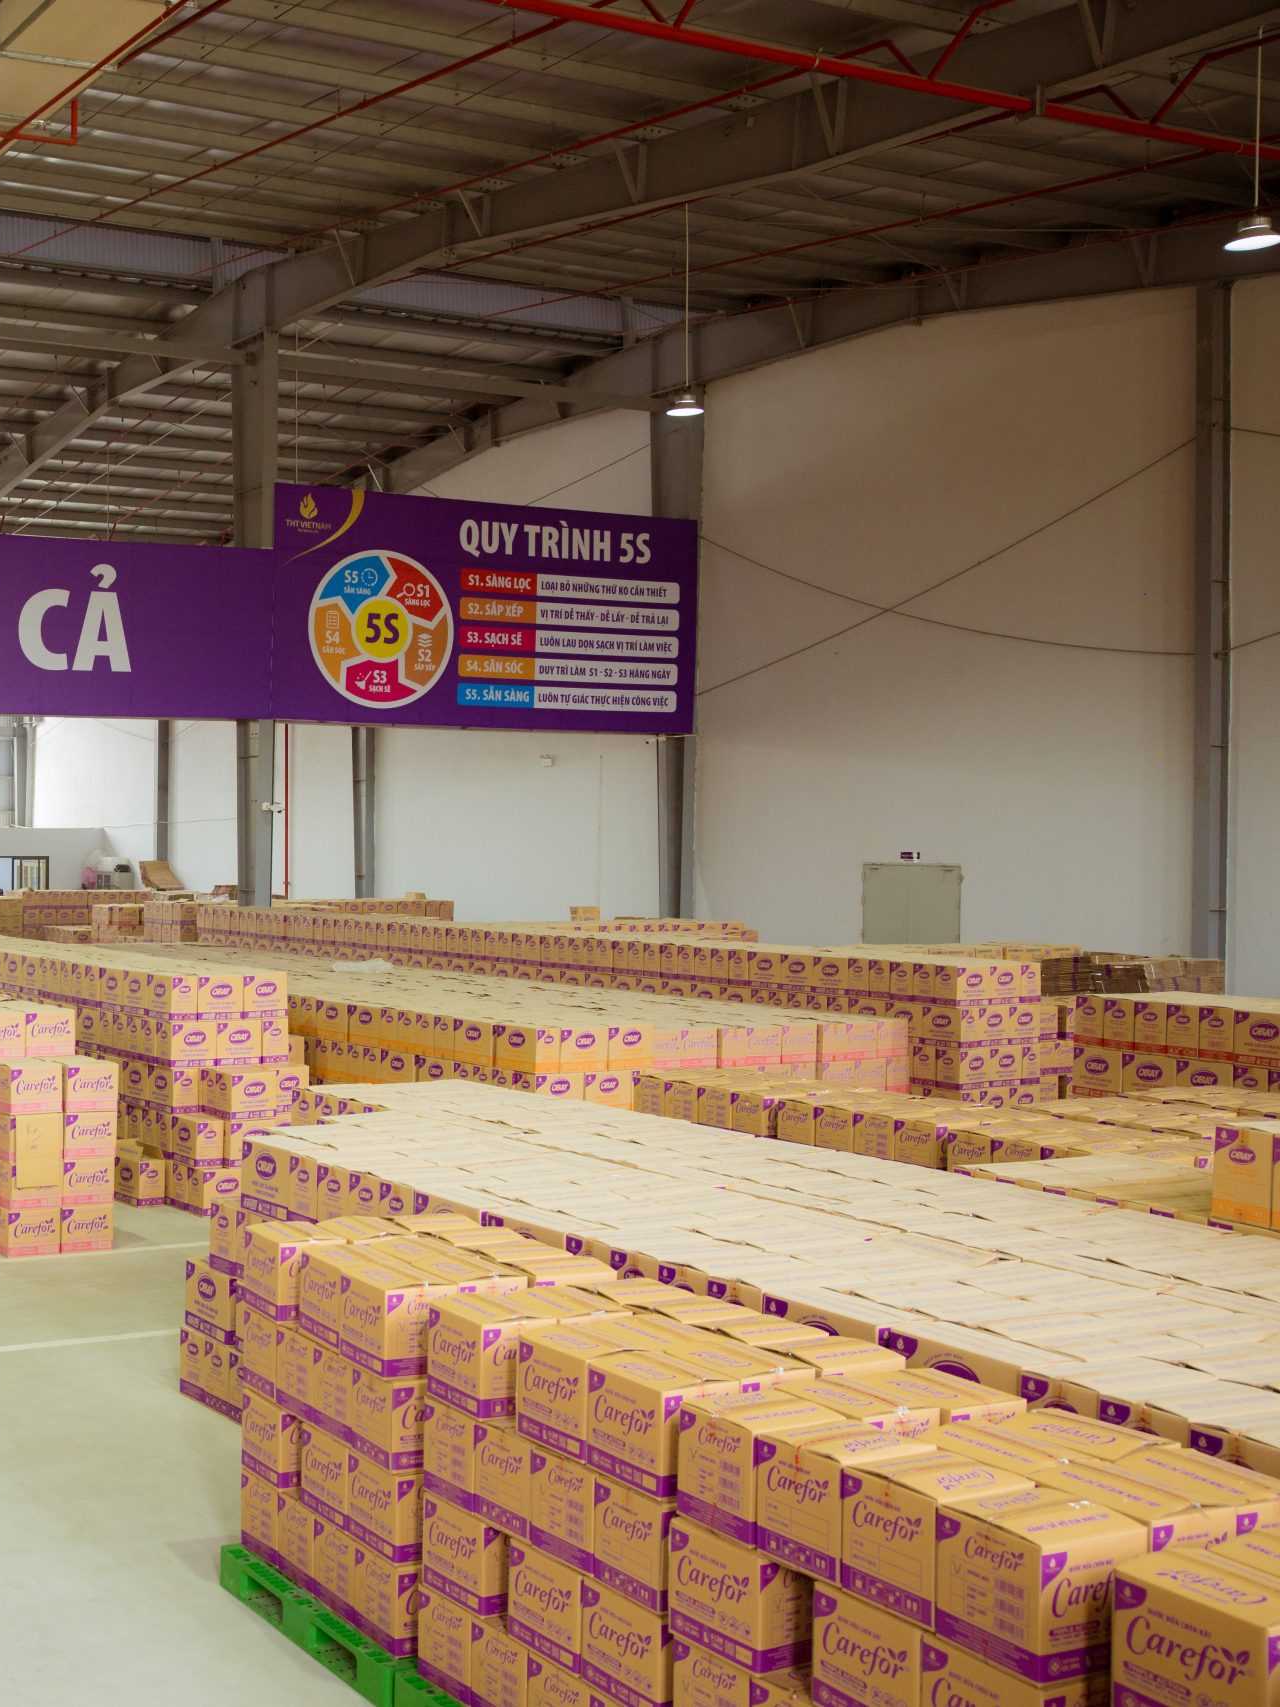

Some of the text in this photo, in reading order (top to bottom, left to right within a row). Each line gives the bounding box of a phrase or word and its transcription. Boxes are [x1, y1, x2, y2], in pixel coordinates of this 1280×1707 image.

[286, 519, 332, 530] THT VIETNAM
[460, 519, 651, 564] QUY TRÌNH 5S
[344, 570, 358, 583] S5
[468, 574, 531, 592] S1. SÀNG LỌC
[417, 584, 430, 597] S1
[542, 581, 558, 593] LOẠI
[560, 580, 570, 592] BỎ
[572, 582, 600, 594] NHỮNG
[620, 586, 628, 596] KO
[468, 599, 523, 617] S2. SẮP XẾP
[18, 564, 131, 673] CẢ
[540, 609, 548, 620] VỊ
[550, 609, 562, 619] TRÍ
[657, 616, 668, 627] LẠI
[326, 630, 339, 644] S4
[365, 612, 400, 644] 5S
[467, 632, 482, 644] S3.
[484, 632, 508, 648] SẠCH
[540, 636, 672, 654] LUÔN LAU DỌN SẠCH VỊ TRÍ LÀM VIỆC
[418, 648, 432, 662] S2
[466, 660, 481, 672] S4.
[505, 660, 523, 674] SÓC
[539, 666, 554, 674] DUY
[556, 666, 568, 675] TRÌ
[570, 666, 586, 676] LÀM
[589, 668, 598, 676] S1
[604, 668, 612, 676] S2
[620, 669, 628, 678] S3
[652, 670, 670, 680] NGÀY
[373, 670, 386, 683] S3
[466, 688, 480, 700] S5.
[504, 688, 530, 702] SÀNG
[538, 692, 668, 708] LUÔN TỰ GIÁC THỰC HIỆN CÔNG VIỆC
[211, 986, 231, 998] OBAY
[256, 984, 276, 996] OBAY
[31, 1022, 67, 1038] Carefor
[184, 1033, 205, 1044] OBAY
[230, 1032, 250, 1044] OBAY
[1252, 1026, 1276, 1038] OBAY
[16, 1079, 54, 1096] Carefor
[72, 1077, 109, 1093] Carefor
[244, 1083, 265, 1094] OBAY
[71, 1124, 108, 1141] Carefor
[256, 1161, 274, 1176] OBAY
[68, 1172, 106, 1188] Carefor
[14, 1221, 51, 1239] Carefor
[66, 1218, 105, 1235] Carefor
[199, 1280, 215, 1296] OBAY
[303, 1272, 335, 1300] Carefor
[343, 1295, 379, 1328] Carefor
[432, 1329, 474, 1366] Carefor
[524, 1364, 576, 1403] Carefor
[594, 1394, 652, 1437] Carefor
[244, 1413, 276, 1443] Carefor
[698, 1426, 740, 1454] Carefor
[305, 1450, 341, 1482] Carefor
[481, 1444, 521, 1475] Carefor
[767, 1465, 826, 1505] Carefor
[352, 1478, 391, 1512] Carefor
[602, 1506, 651, 1542] Carefor
[852, 1500, 921, 1542] Carefor
[428, 1520, 475, 1560] Carefor
[964, 1536, 1022, 1572] Carefor
[677, 1555, 747, 1604] Carefor
[514, 1570, 569, 1614] Carefor
[589, 1612, 648, 1660] Carefor
[822, 1622, 905, 1679] Carefor
[1126, 1615, 1246, 1685] Carefor
